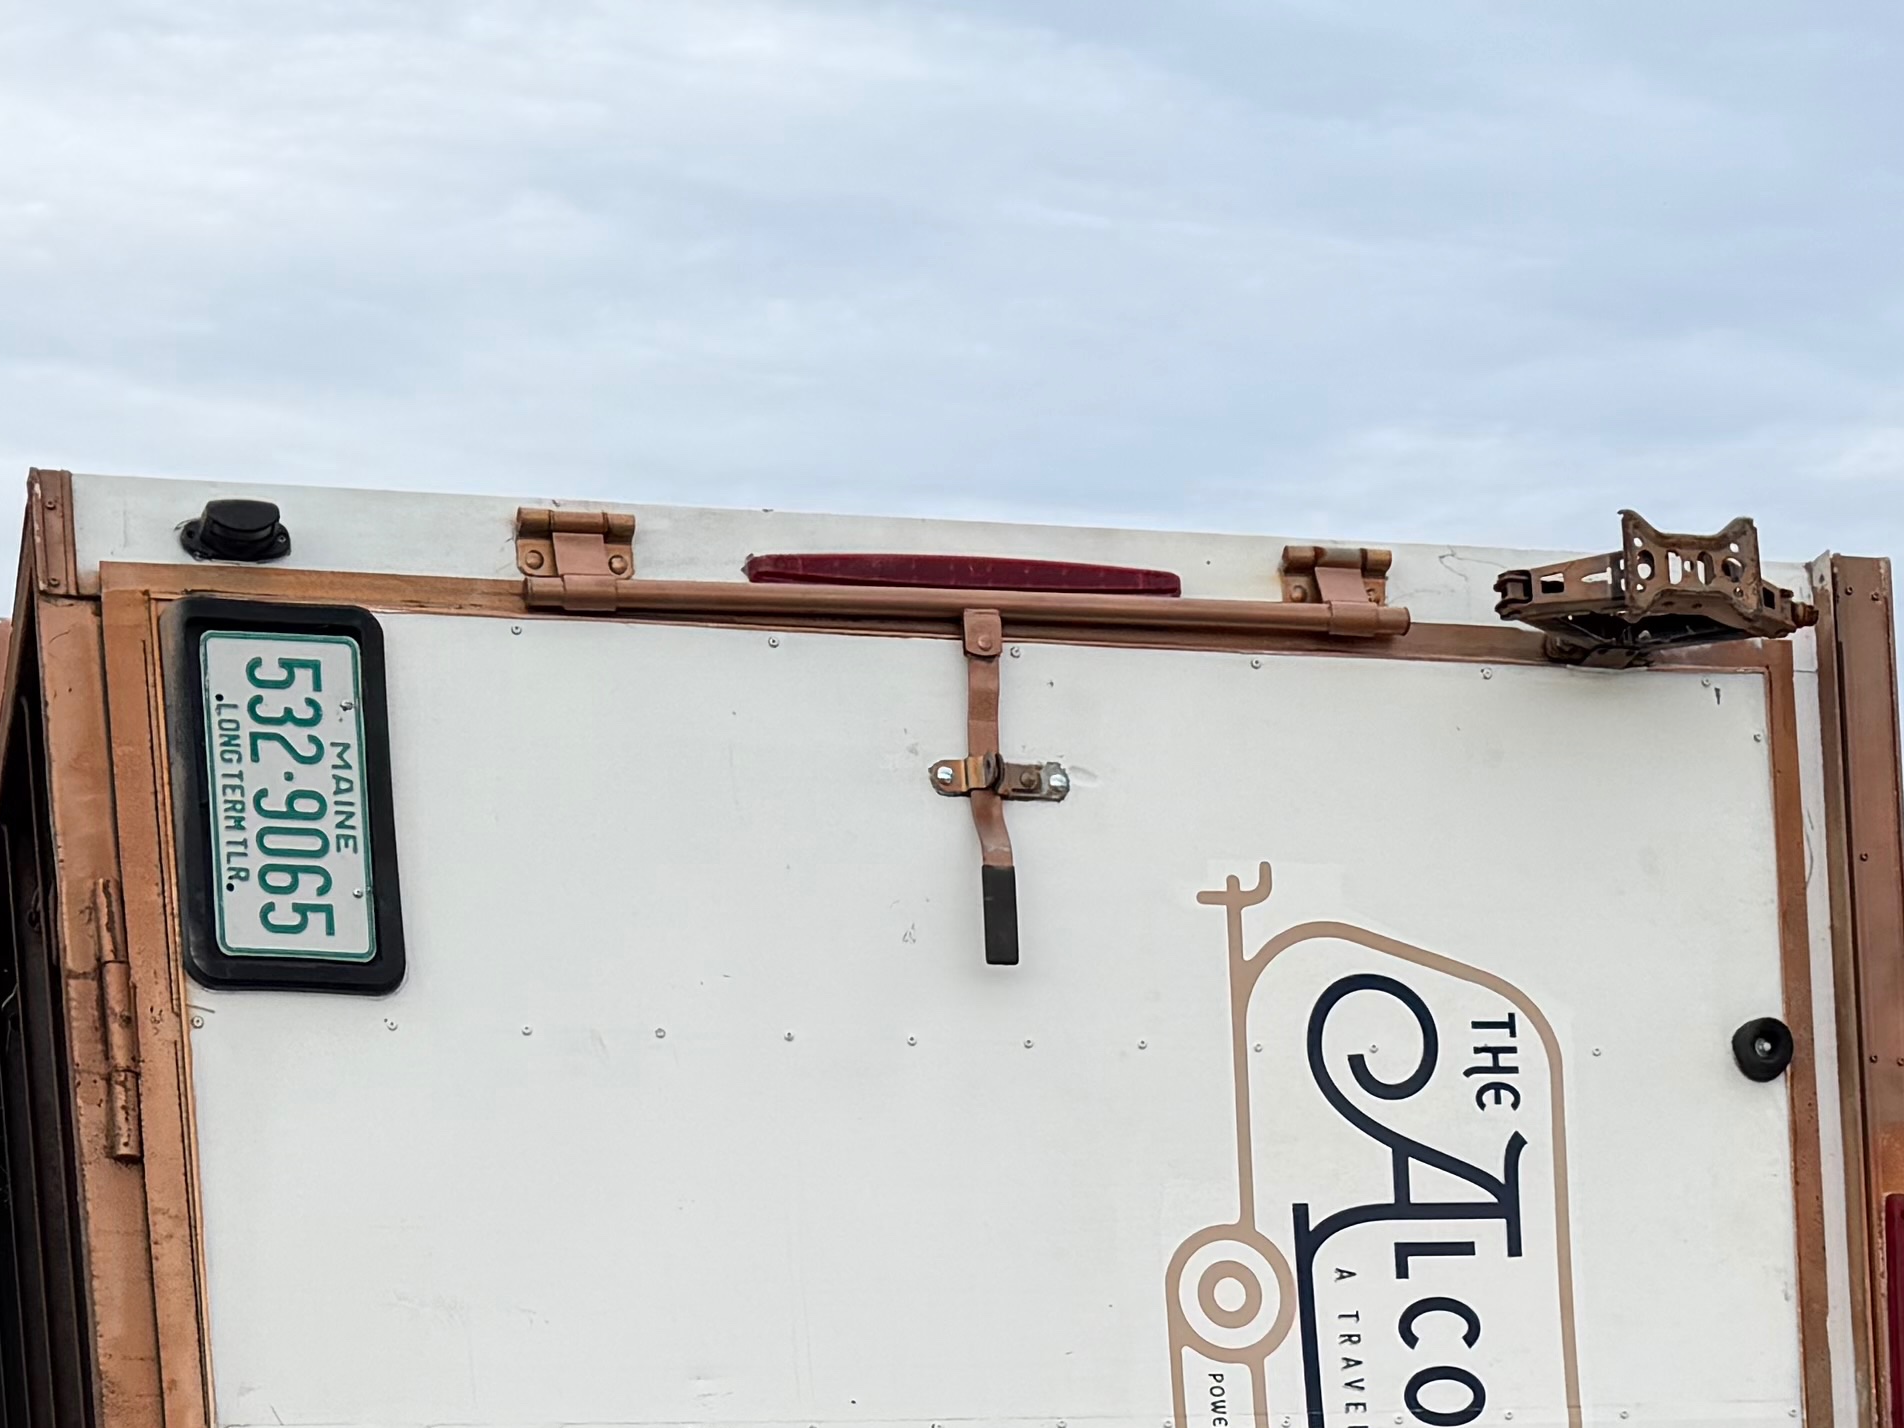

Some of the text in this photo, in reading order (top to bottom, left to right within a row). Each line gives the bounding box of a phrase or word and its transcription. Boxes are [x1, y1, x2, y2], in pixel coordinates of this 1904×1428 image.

[216, 703, 251, 883] LONG TERM TLR
[330, 742, 358, 854] MAINE
[1462, 1012, 1521, 1112] THE
[1334, 1267, 1358, 1282] A
